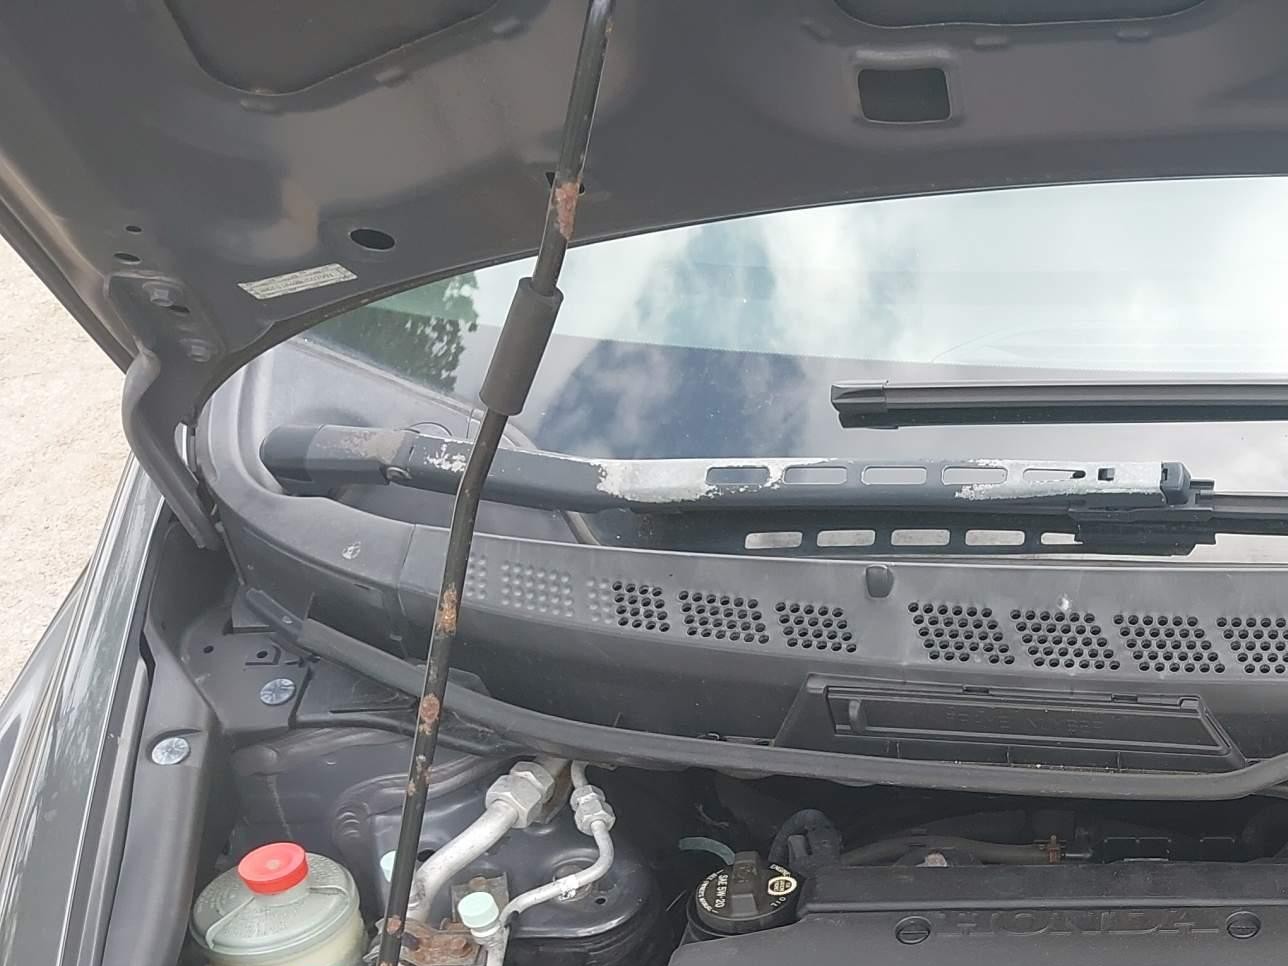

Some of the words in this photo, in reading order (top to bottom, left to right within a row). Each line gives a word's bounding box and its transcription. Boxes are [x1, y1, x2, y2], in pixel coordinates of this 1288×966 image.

[717, 874, 729, 886] SAE
[715, 886, 728, 908] 5W-20
[770, 896, 787, 907] OIL
[935, 908, 1220, 936] HONDA
